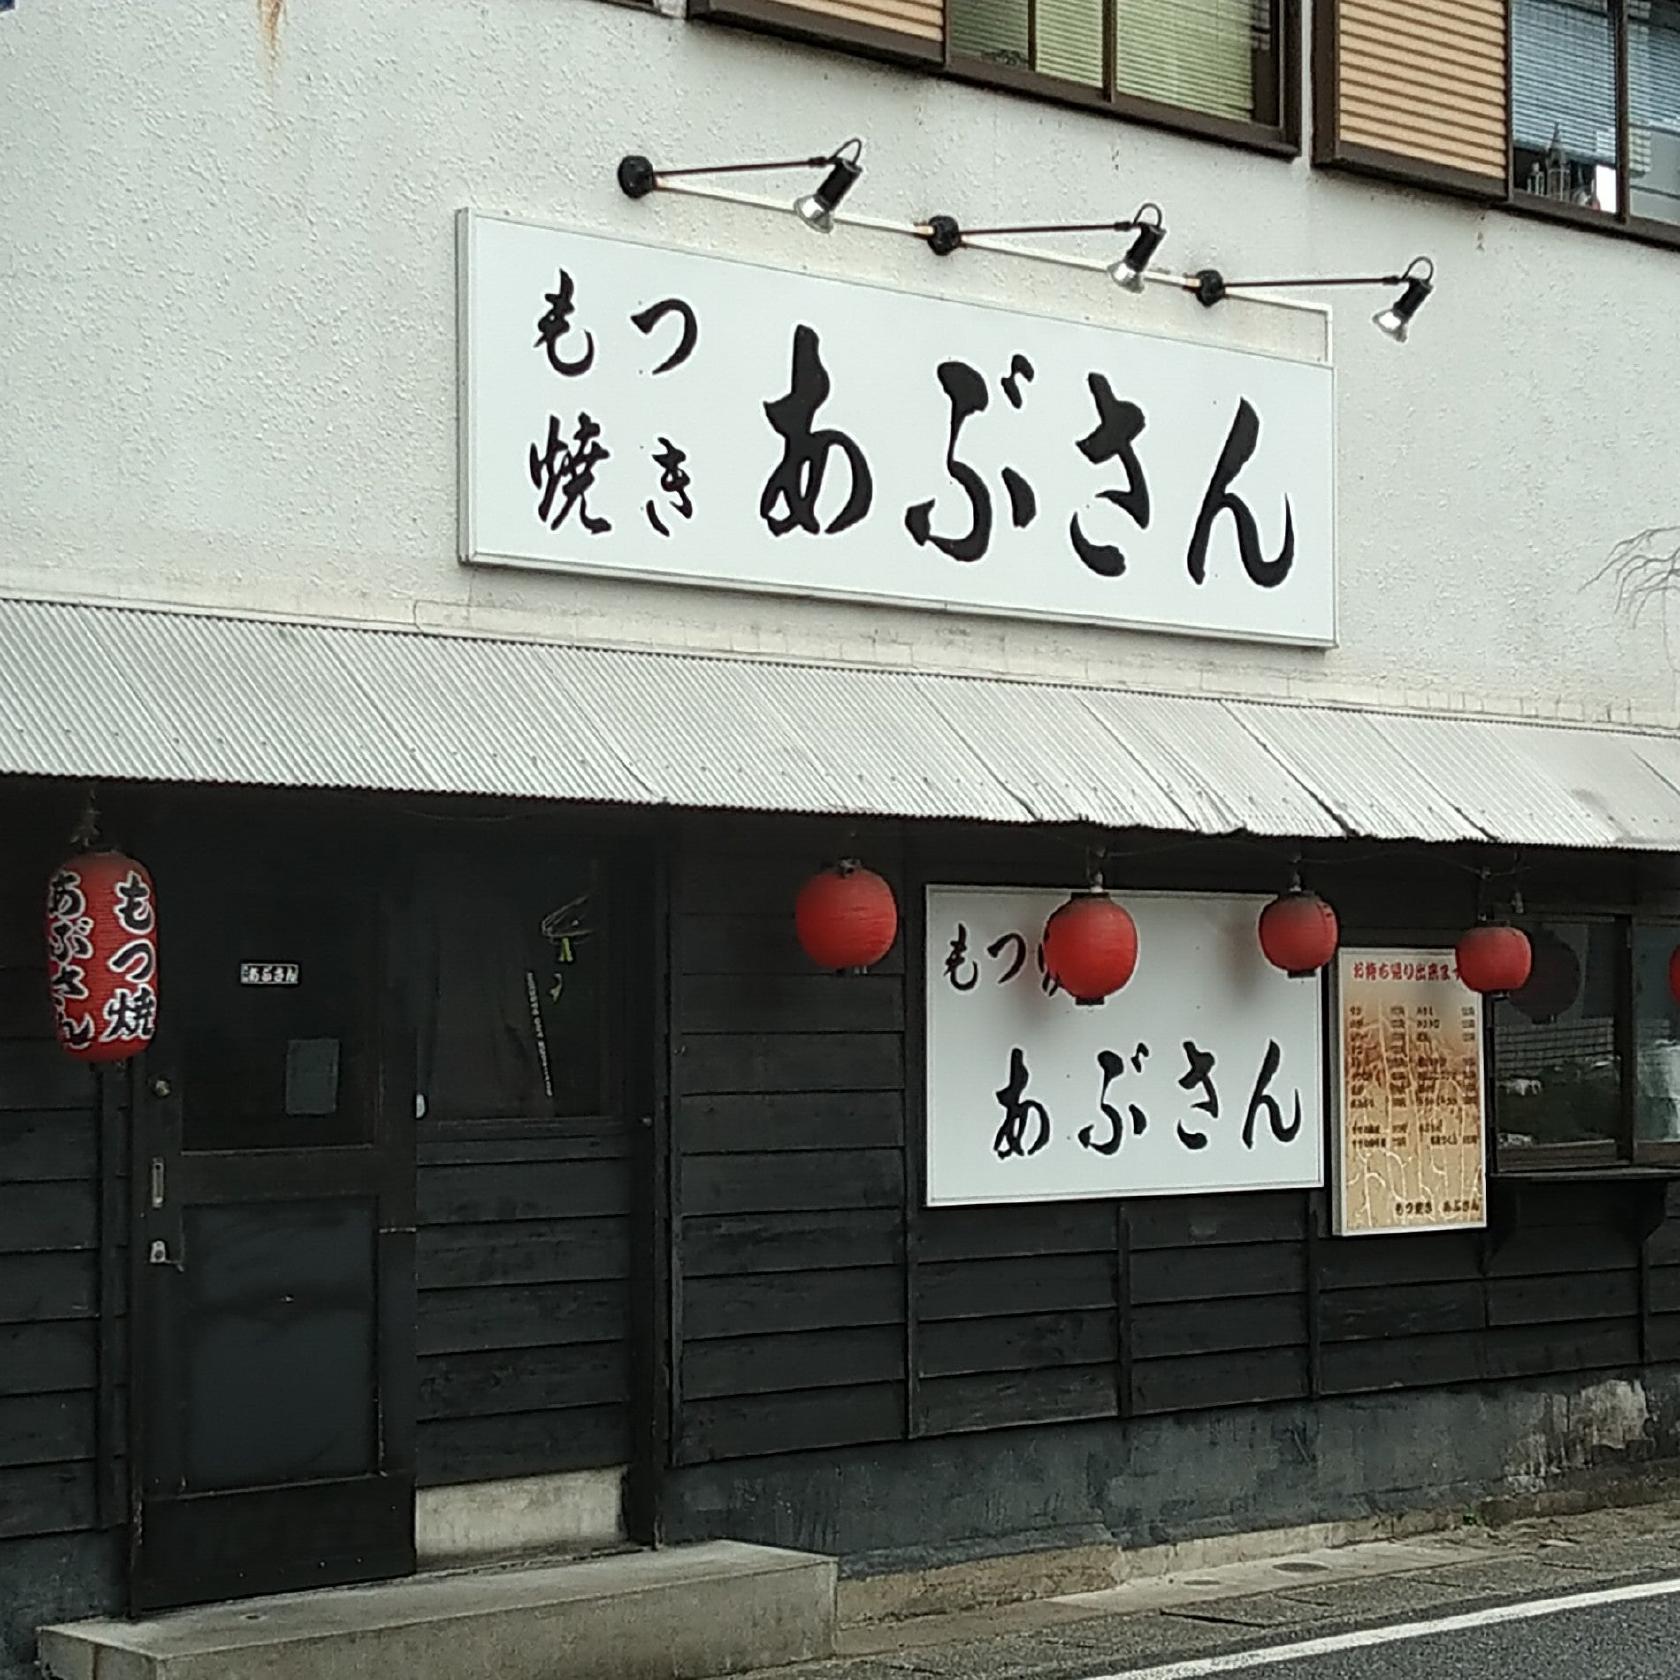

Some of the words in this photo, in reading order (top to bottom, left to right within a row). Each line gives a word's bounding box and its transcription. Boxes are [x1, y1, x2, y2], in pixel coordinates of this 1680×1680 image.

[533, 268, 698, 377] もつ
[530, 412, 693, 537] 焼き
[760, 324, 1295, 588] あぶさん
[48, 871, 94, 1049] あぶさん
[99, 870, 157, 1042] もつ焼
[944, 923, 1060, 997] もつ
[993, 1038, 1302, 1160] あぶさん
